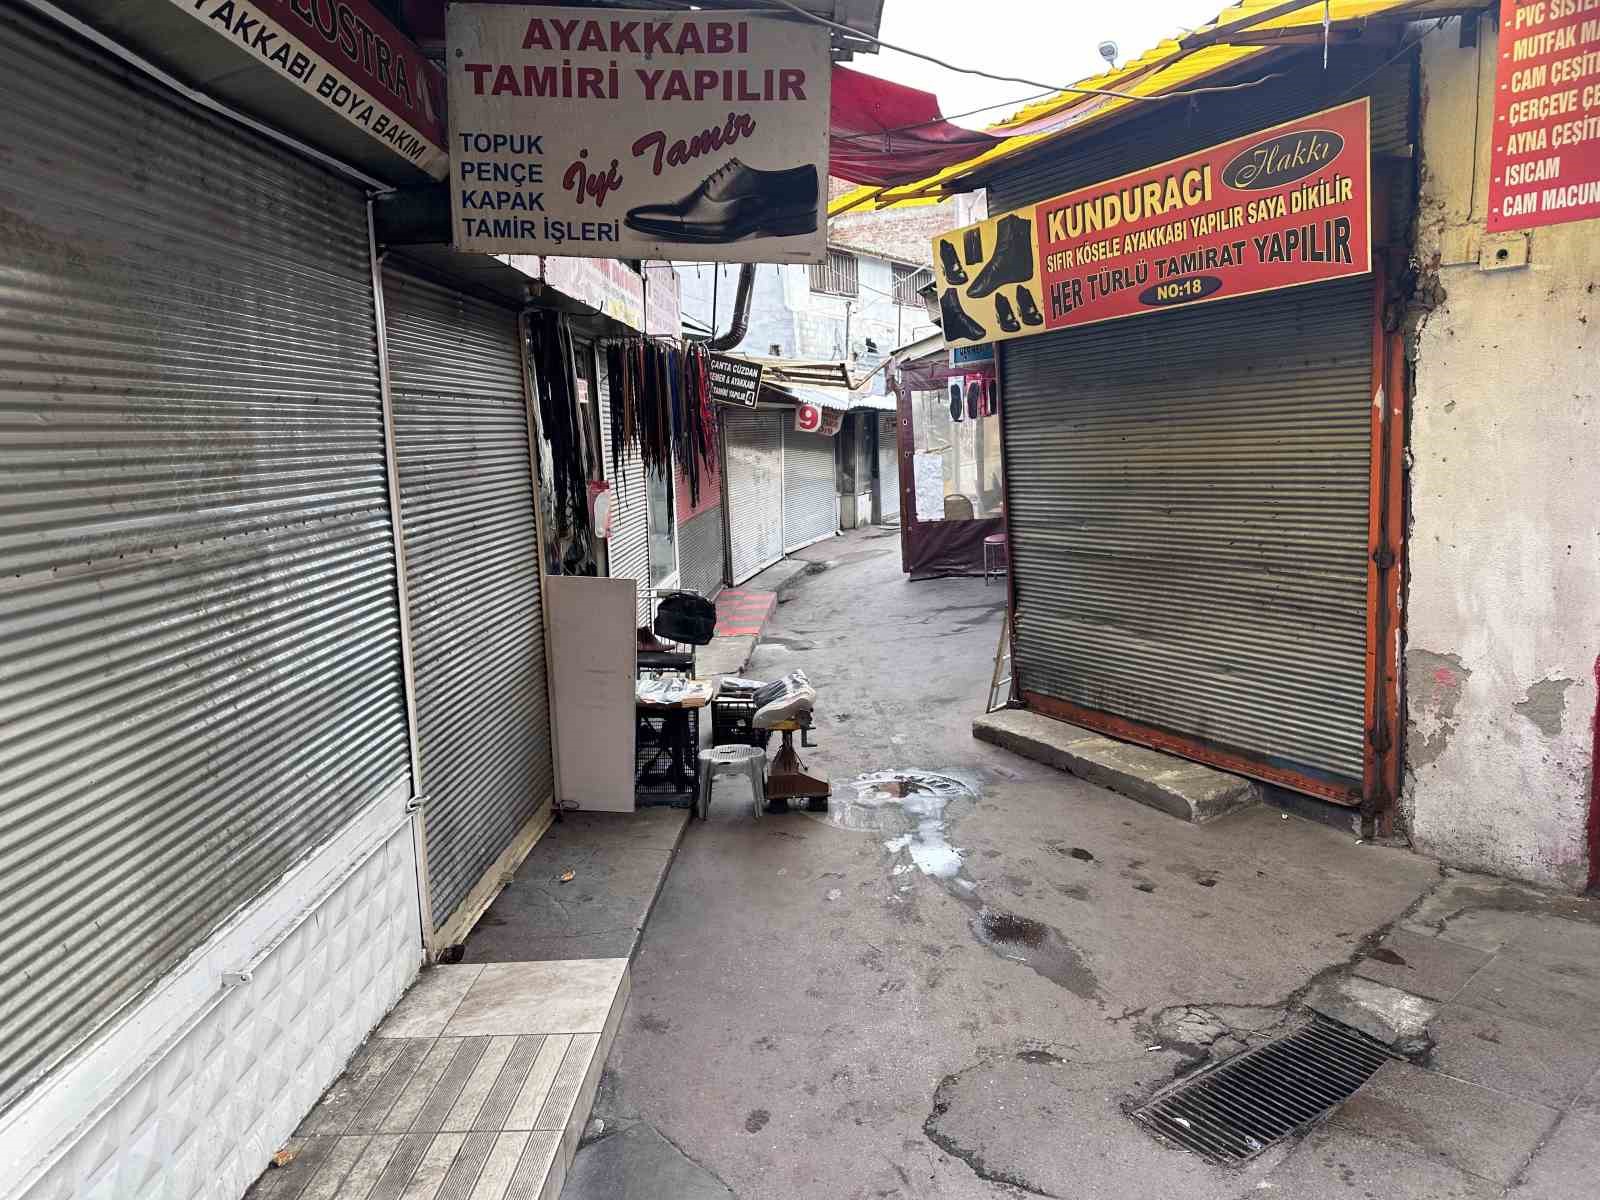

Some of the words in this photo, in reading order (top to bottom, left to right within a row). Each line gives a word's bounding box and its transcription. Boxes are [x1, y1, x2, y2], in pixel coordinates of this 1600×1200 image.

[1515, 2, 1545, 30] PVC
[522, 17, 749, 54] AYAKKABI
[1513, 24, 1577, 62] MUTFAK
[464, 58, 619, 101] TAMİRİ
[634, 67, 807, 101] YAPILIR
[1511, 64, 1547, 93] CAM
[316, 73, 375, 127] BOYA
[371, 116, 427, 161] BAKIM
[1508, 89, 1578, 128] ÇERÇEVE
[458, 132, 544, 155] TOPUK
[1506, 127, 1547, 156] AYNA
[460, 162, 544, 188] PENÇE
[562, 148, 624, 208] İyi
[631, 111, 757, 177] Tamir
[1234, 135, 1330, 188] Hakkı
[1504, 156, 1560, 187] ISICAM
[461, 190, 545, 212] KAPAK
[1046, 165, 1213, 244] KUNDURACI
[1503, 191, 1538, 217] CAM
[461, 216, 537, 241] TAMİR
[543, 216, 620, 245] İŞLERİ
[1046, 250, 1074, 273] SIFIR
[1075, 239, 1121, 266] KÖSELE
[1123, 226, 1188, 255] AYAKKABI
[1191, 210, 1243, 237] YAPILIR
[1247, 200, 1287, 225] SAYA
[1291, 175, 1353, 215] DİKİLİR
[1049, 280, 1082, 318] HER
[1087, 260, 1148, 297] TÜRLÜ
[1154, 241, 1246, 277] TAMİRAT
[1256, 216, 1352, 264] YAPILIR
[1155, 278, 1202, 301] NO:18
[799, 405, 818, 430] 9
